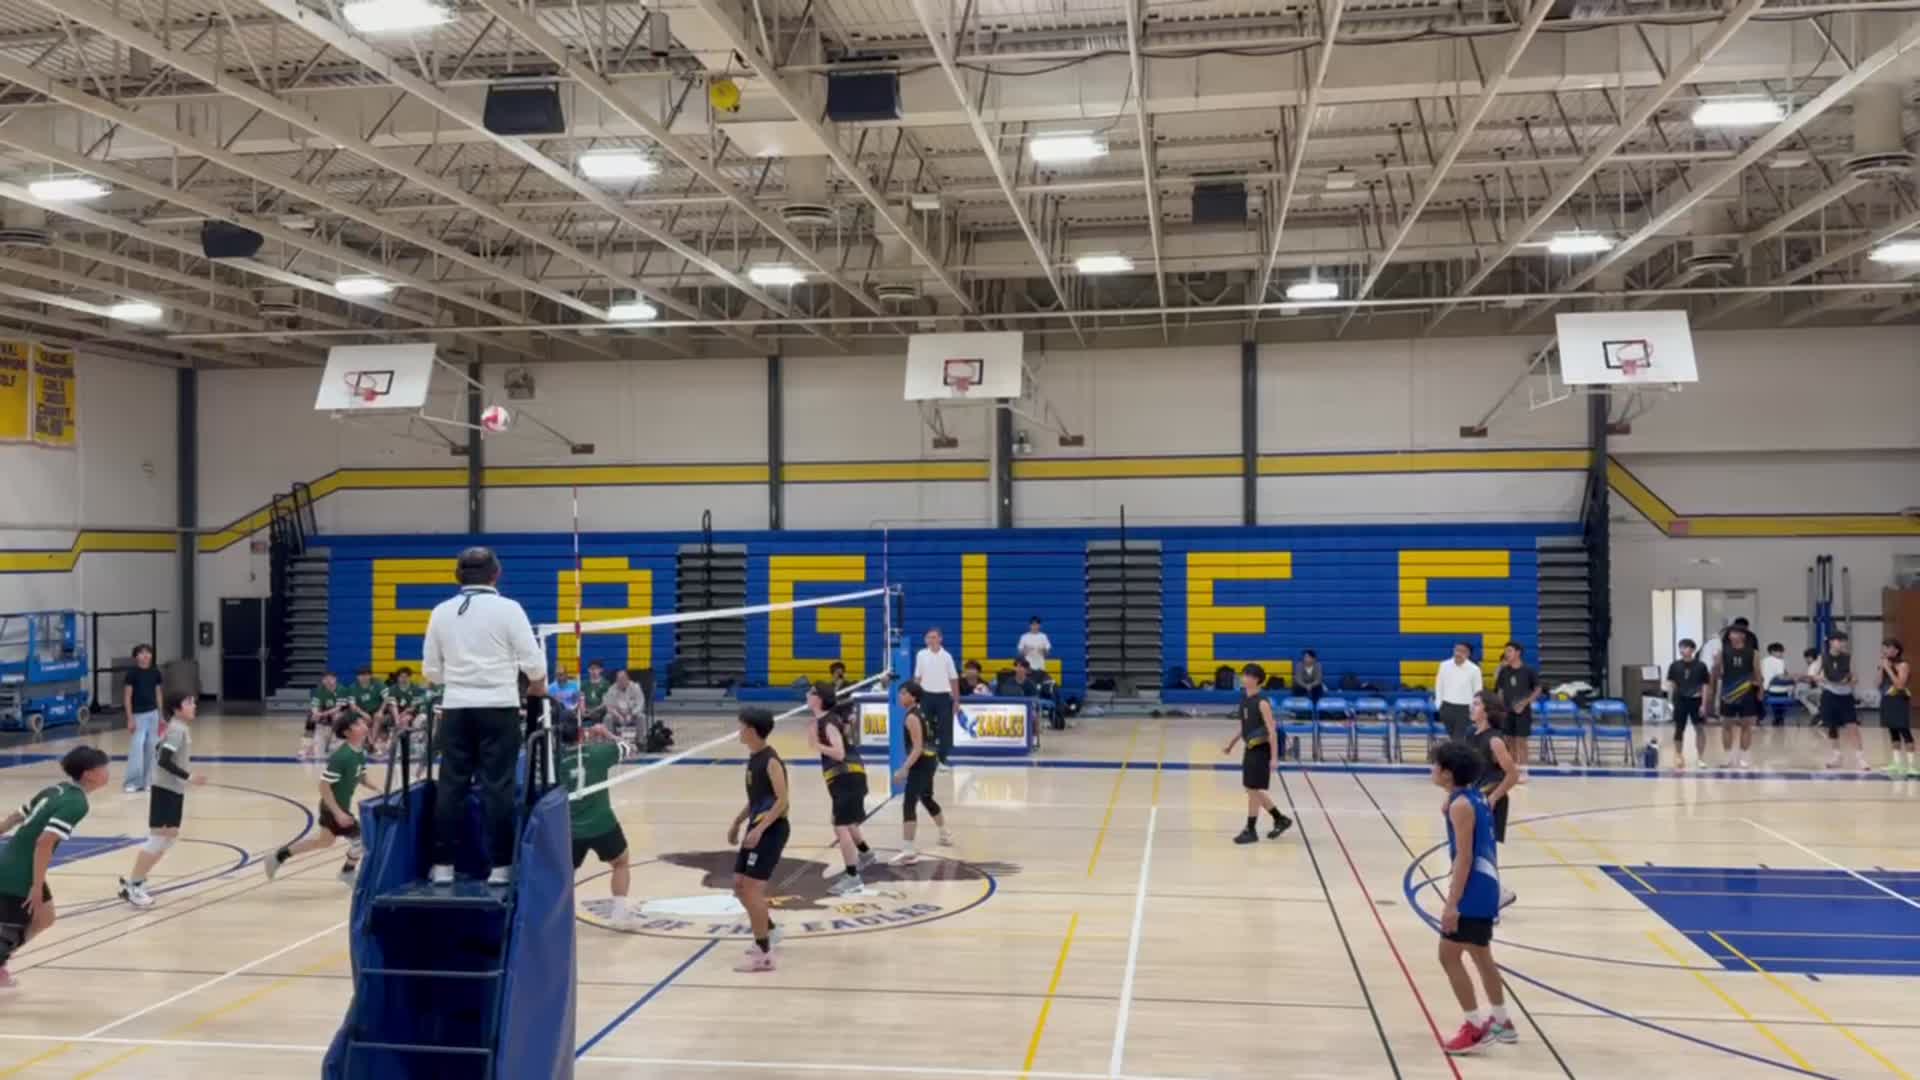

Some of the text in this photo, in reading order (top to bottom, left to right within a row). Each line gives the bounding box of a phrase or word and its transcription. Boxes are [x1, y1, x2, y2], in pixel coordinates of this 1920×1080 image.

[371, 550, 1510, 688] EAGLES
[863, 712, 1025, 738] OAK EAGLES
[801, 903, 944, 932] EAGLES
